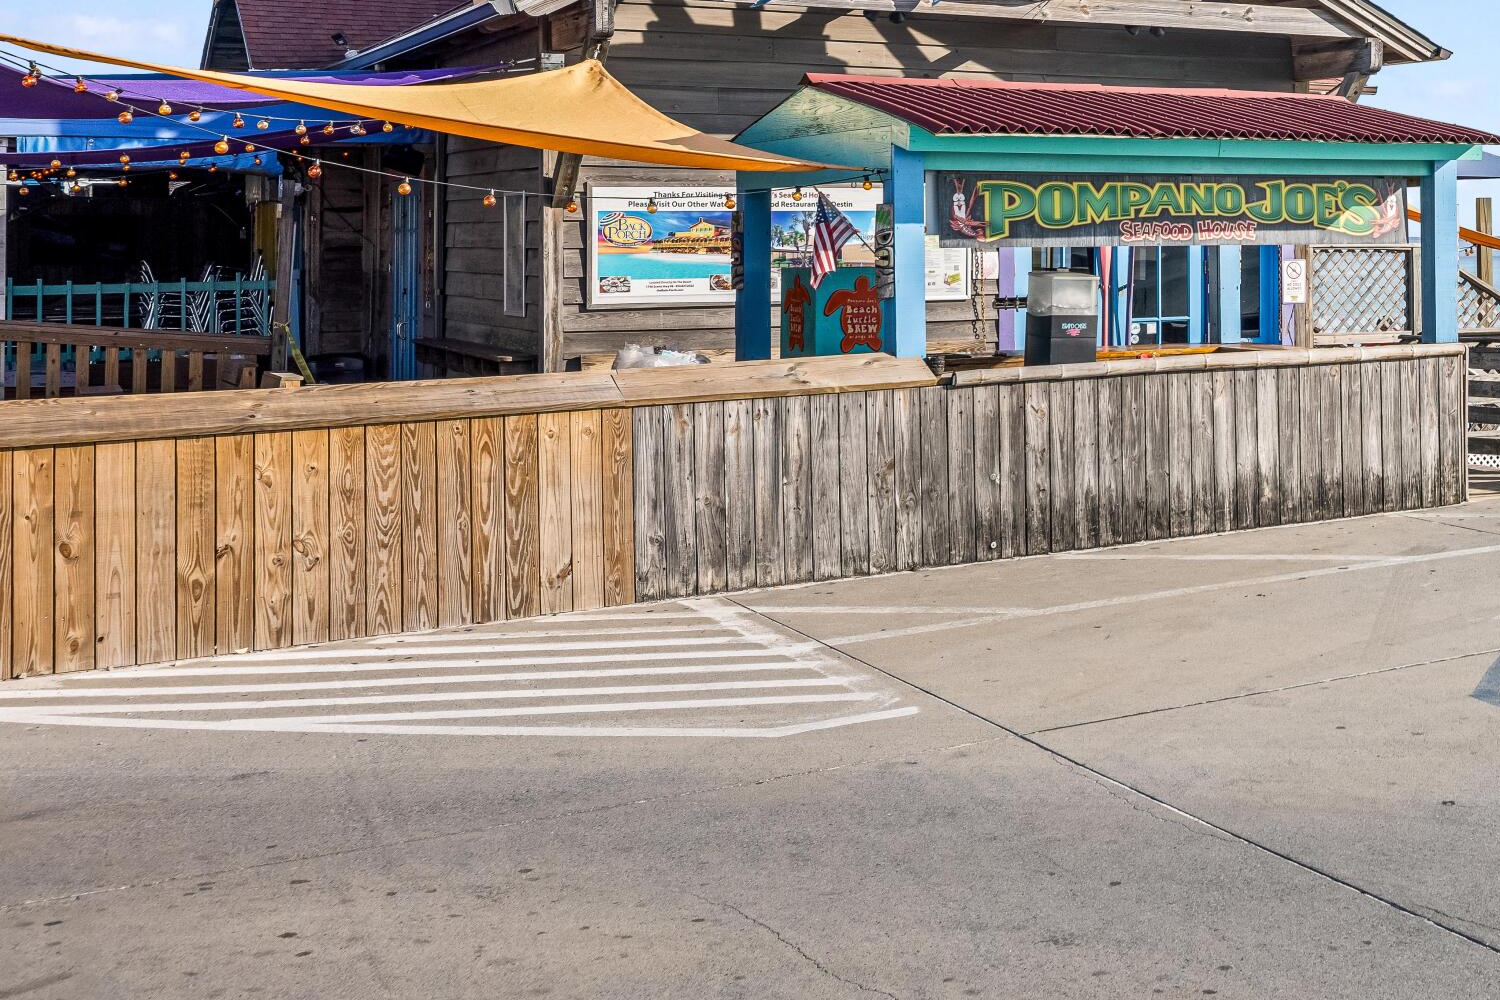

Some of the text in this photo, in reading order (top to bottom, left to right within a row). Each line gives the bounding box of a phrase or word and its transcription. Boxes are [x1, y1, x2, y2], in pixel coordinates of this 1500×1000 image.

[653, 191, 680, 199] Thanks
[672, 200, 685, 208] Our
[687, 200, 708, 208] Other
[978, 179, 1380, 242] POMPANO JOE'S
[1120, 219, 1257, 242] SEAFOOD HOUSE
[846, 305, 878, 314] Beach
[846, 314, 877, 324] Turtle
[847, 324, 877, 334] BREW
